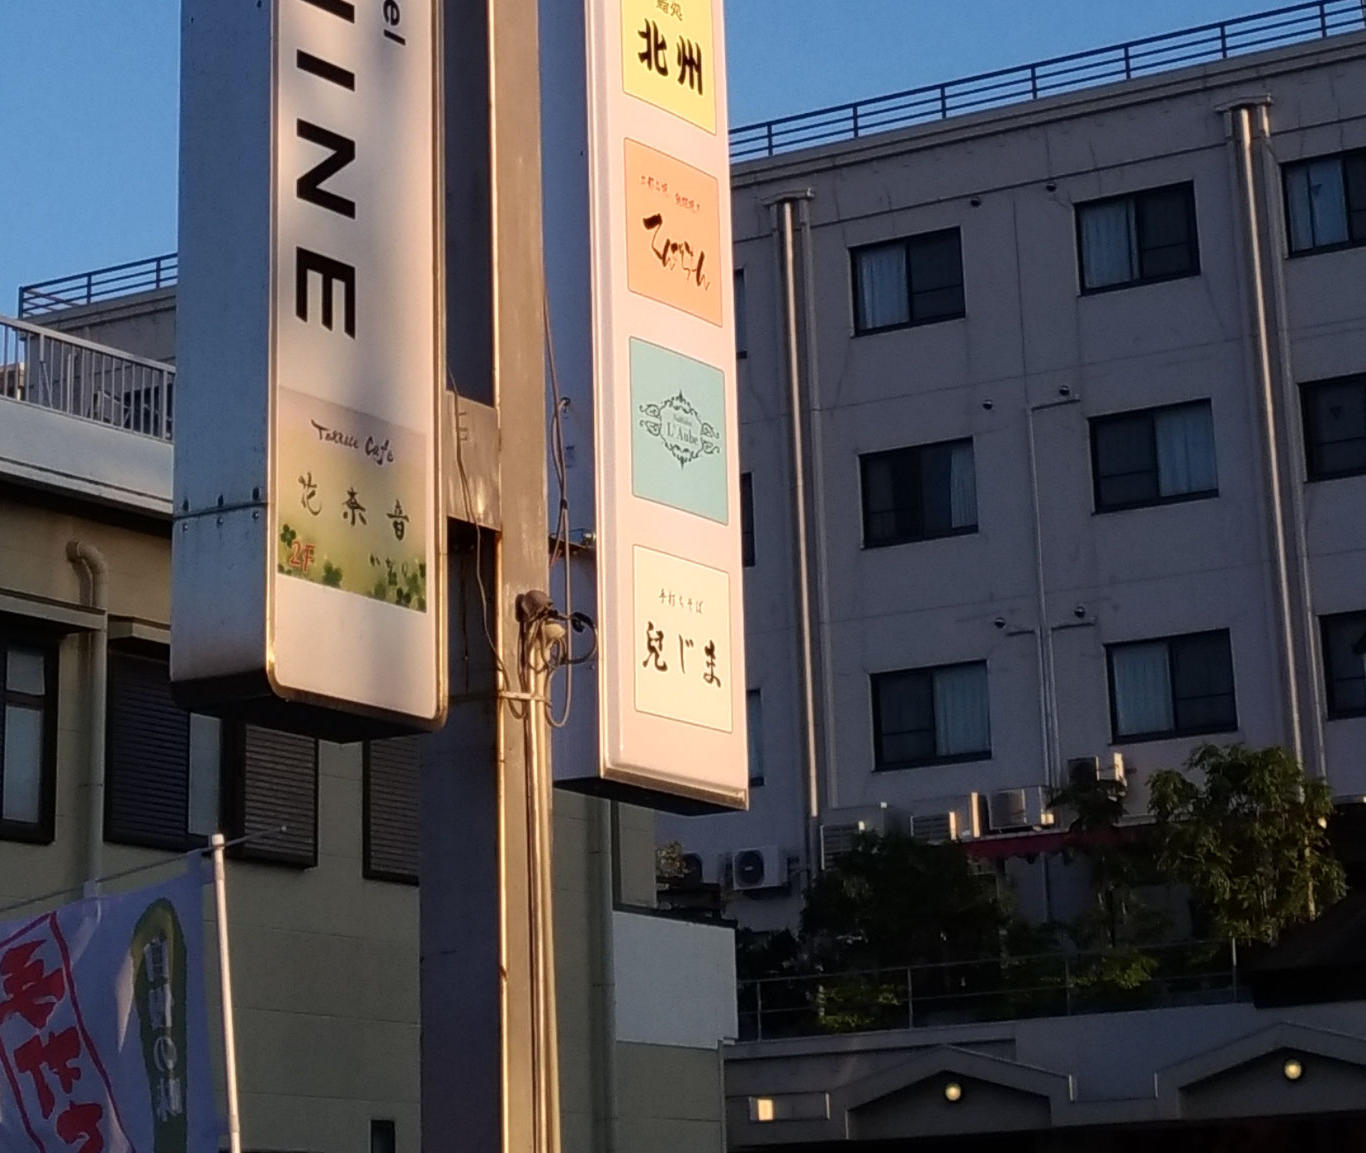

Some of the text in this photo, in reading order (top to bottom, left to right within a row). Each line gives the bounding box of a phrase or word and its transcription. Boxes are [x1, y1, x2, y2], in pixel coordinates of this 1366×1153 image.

[637, 18, 703, 96] 北州
[289, 540, 316, 573] 2F
[658, 588, 704, 614] 手打ちそば
